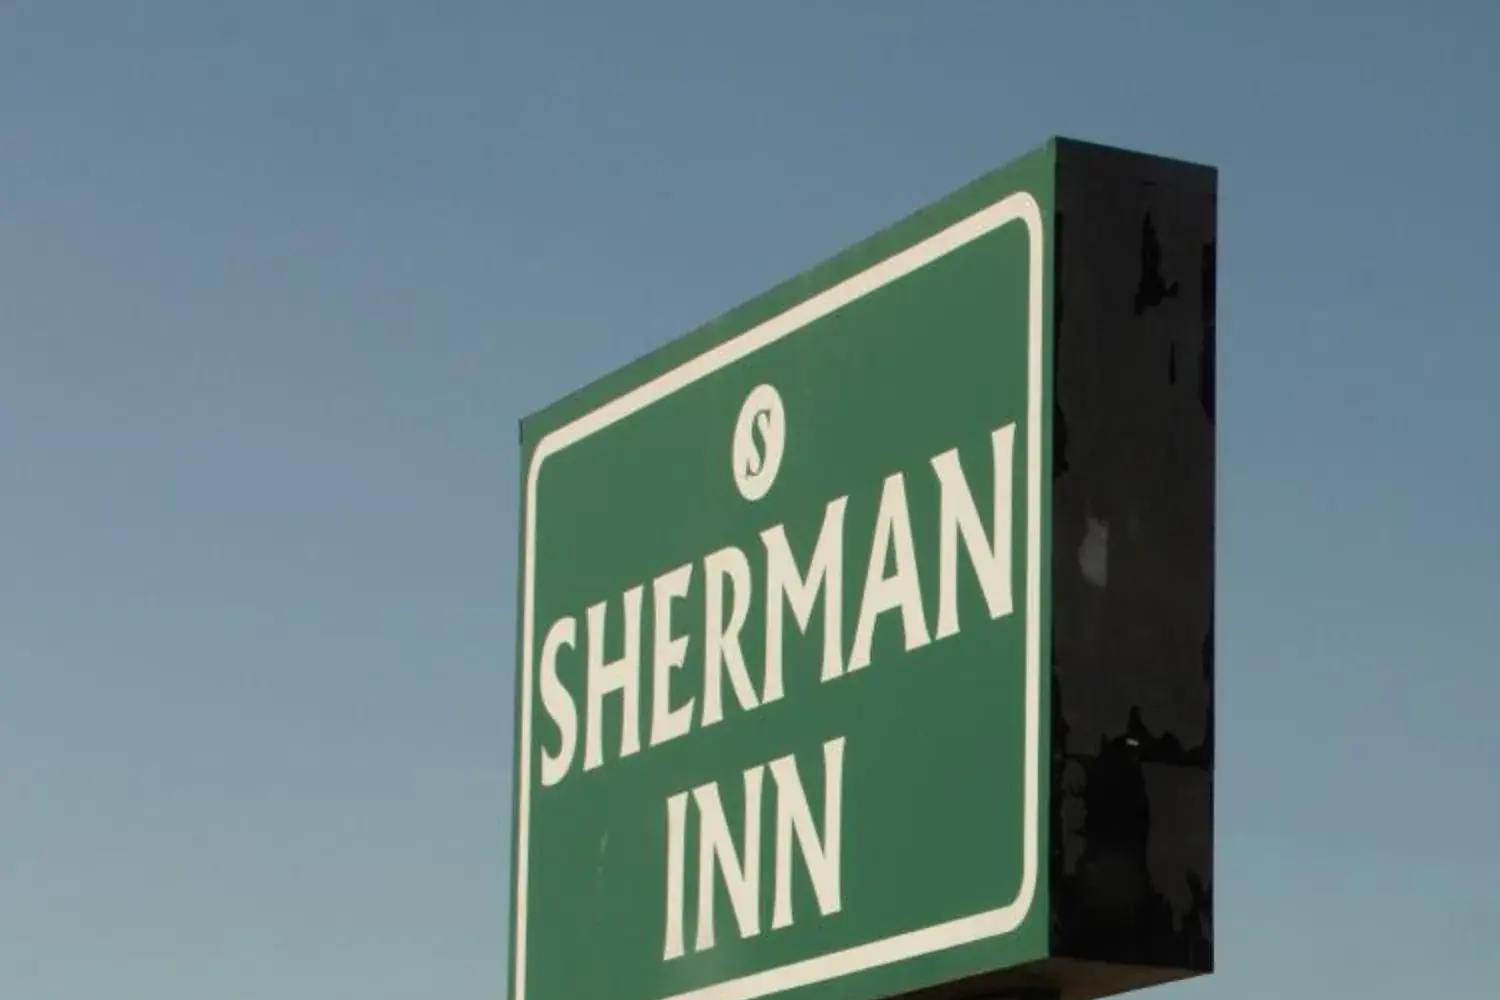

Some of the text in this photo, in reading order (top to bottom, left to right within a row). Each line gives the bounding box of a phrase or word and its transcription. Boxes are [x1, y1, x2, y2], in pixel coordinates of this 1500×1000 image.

[745, 408, 771, 480] S
[539, 421, 1017, 787] SHERMAN
[663, 736, 846, 962] INN
